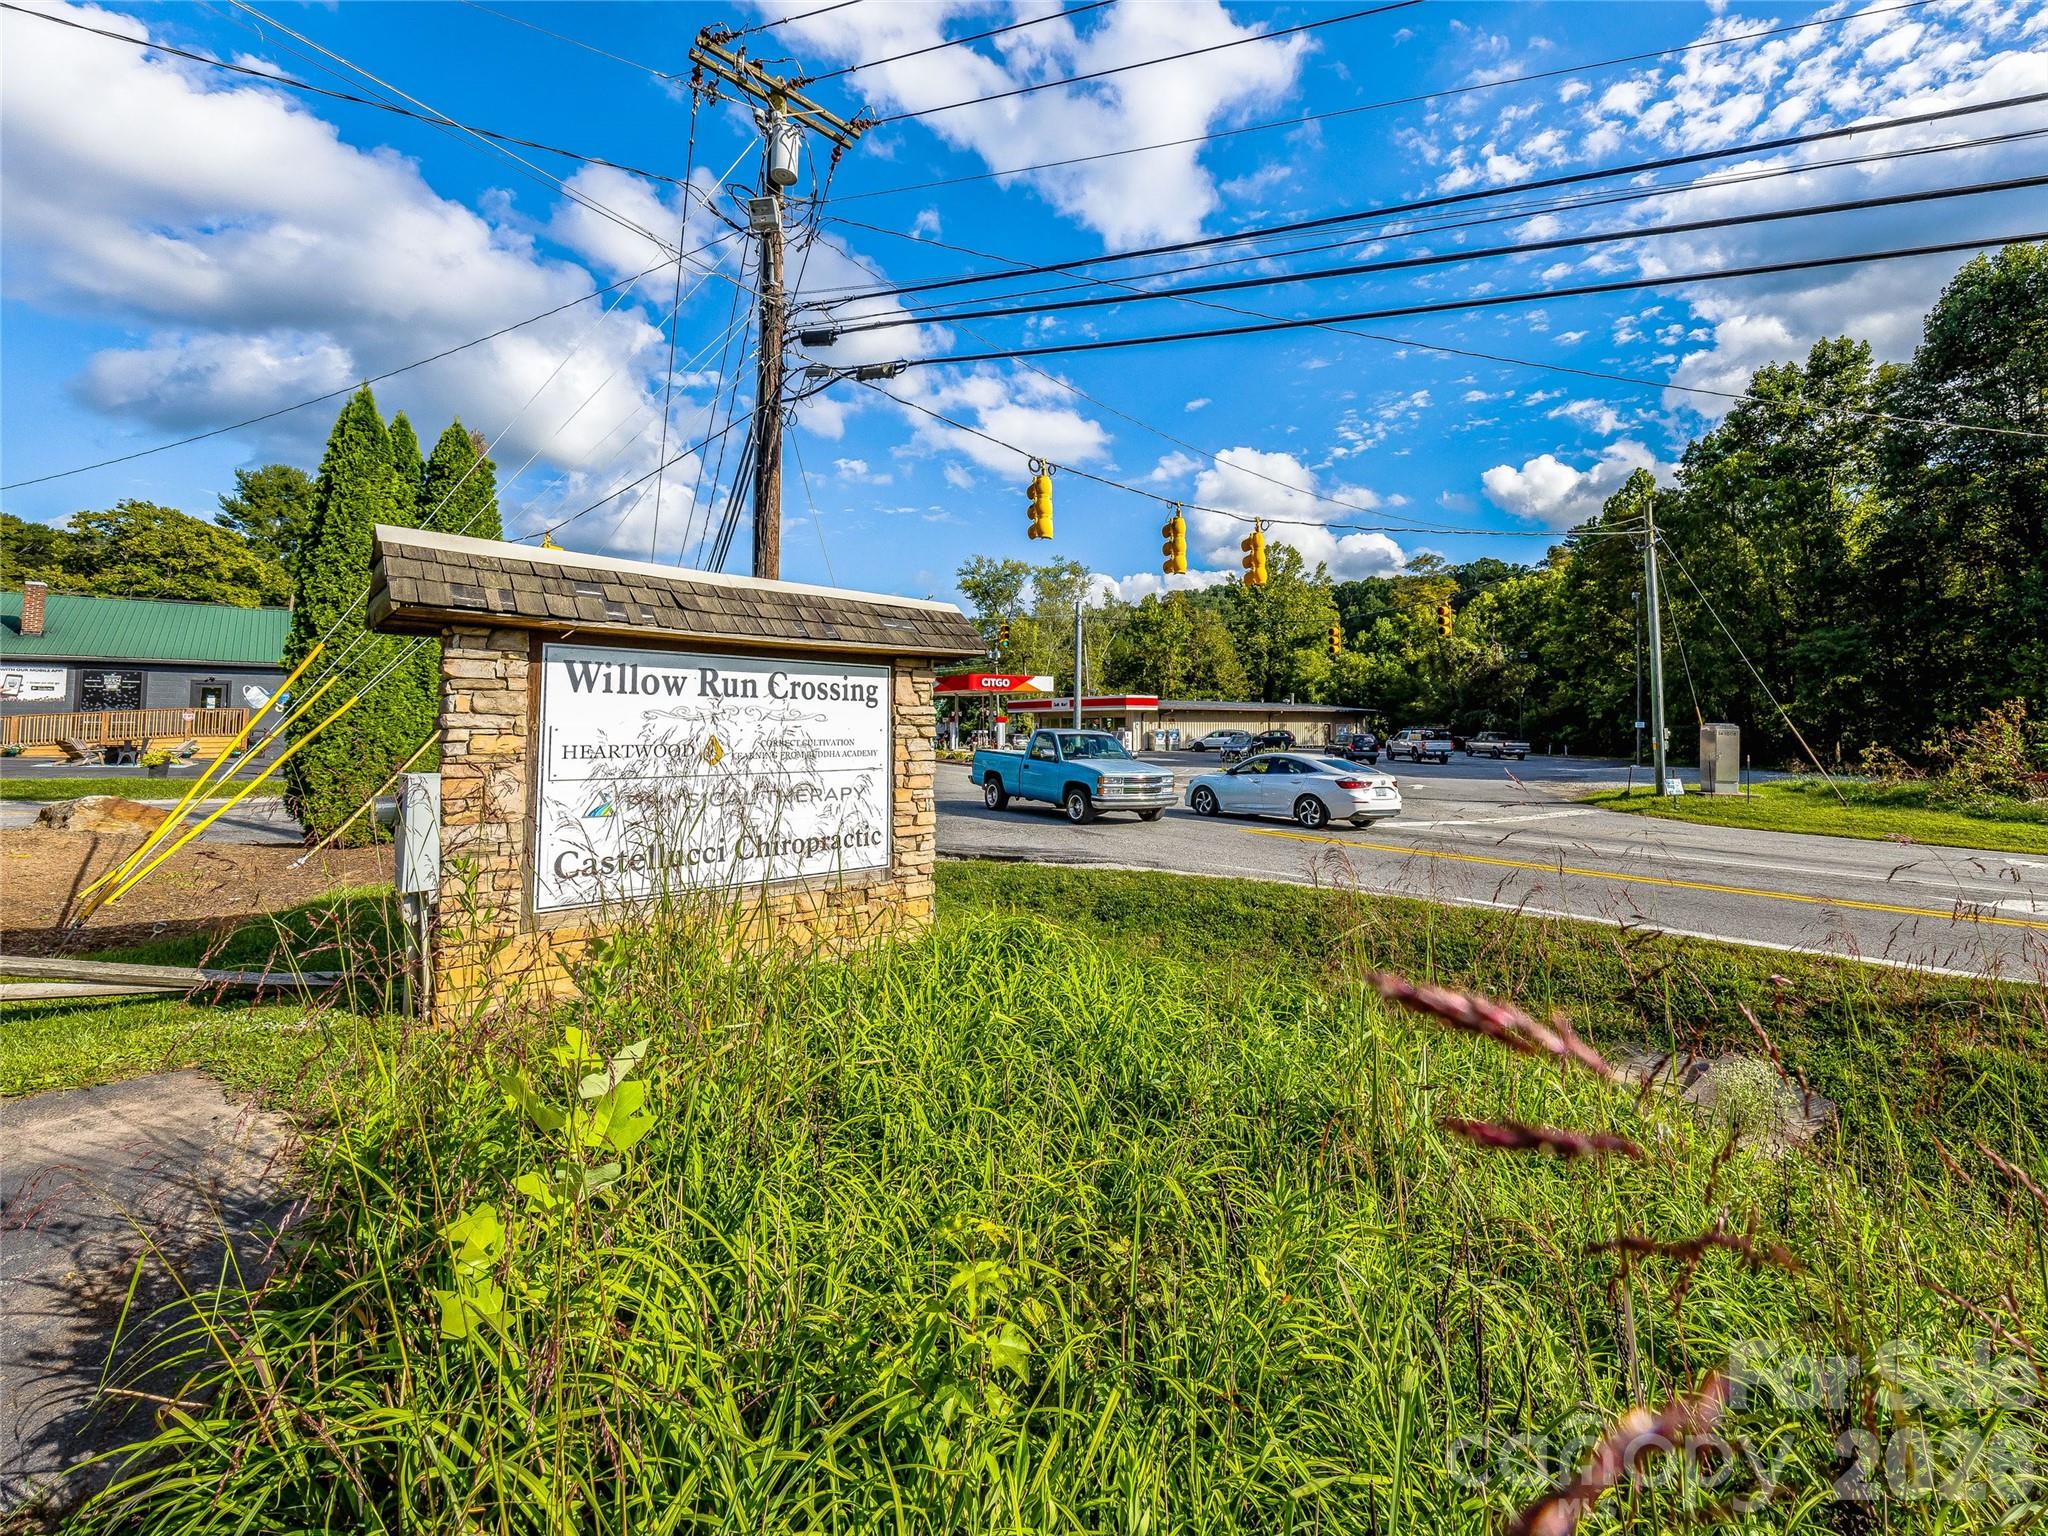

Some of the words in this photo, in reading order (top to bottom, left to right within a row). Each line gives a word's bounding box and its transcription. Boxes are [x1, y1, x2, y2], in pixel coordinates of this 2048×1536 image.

[563, 659, 688, 697] Willow
[697, 667, 759, 698] Run
[767, 671, 879, 709] Crossing
[981, 677, 1010, 687] CITGO
[760, 739, 801, 747] CORRECT
[802, 738, 855, 747] CULTIVATION
[562, 743, 695, 760] HEARTWOOD
[780, 751, 803, 761] FROM
[804, 750, 840, 759] BUDDHA
[842, 749, 878, 758] ACADEMY
[554, 838, 726, 879] Castellucci
[736, 824, 882, 860] Chiropractic
